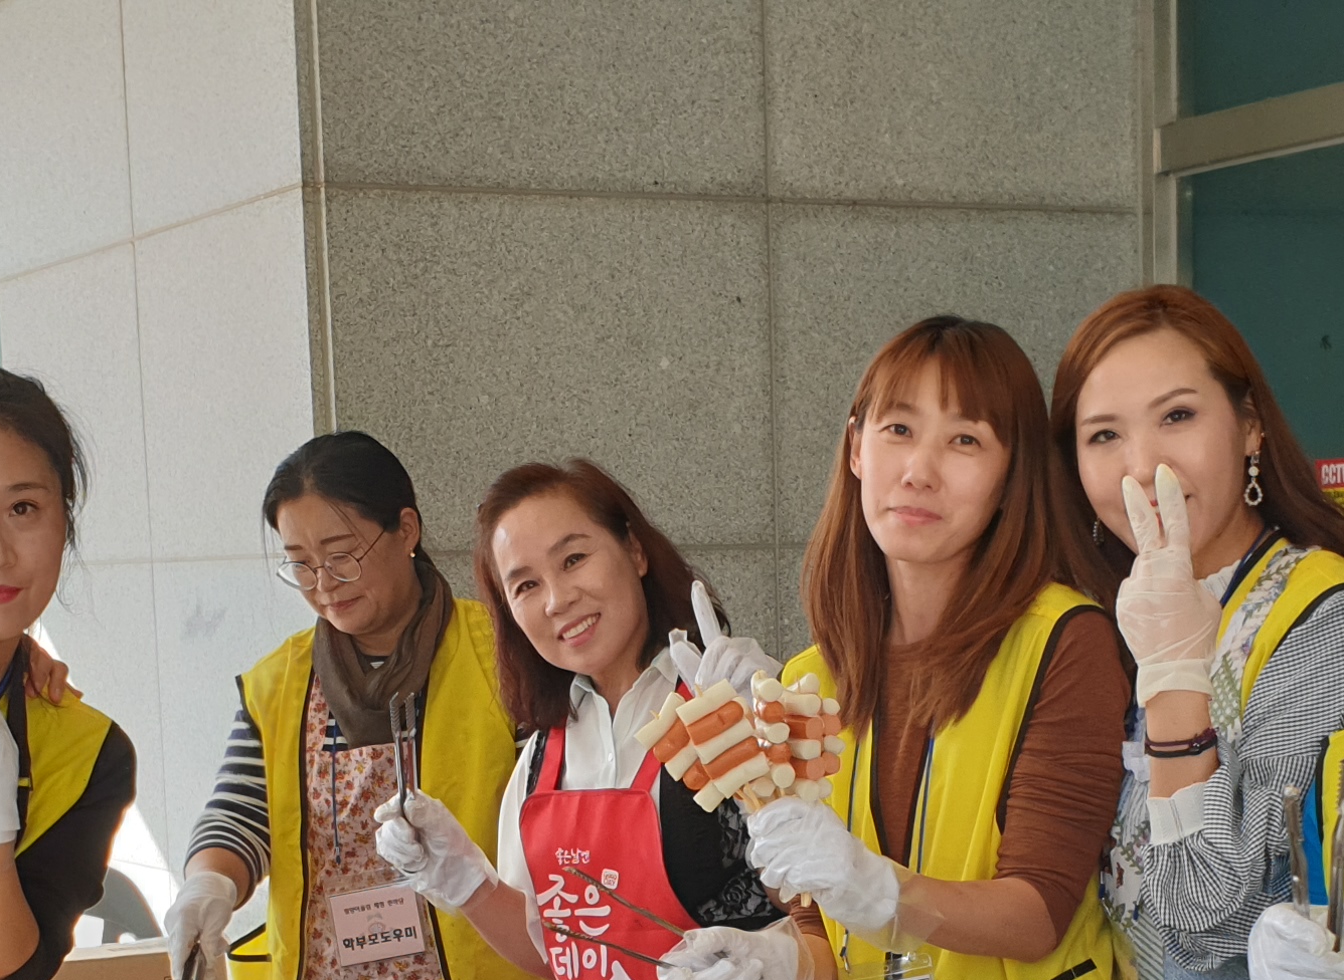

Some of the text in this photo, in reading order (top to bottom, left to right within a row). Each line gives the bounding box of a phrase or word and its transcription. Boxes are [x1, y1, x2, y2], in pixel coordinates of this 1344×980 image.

[536, 874, 612, 943] 좋은
[342, 926, 417, 951] 학부모도우미
[549, 941, 608, 980] 데이
